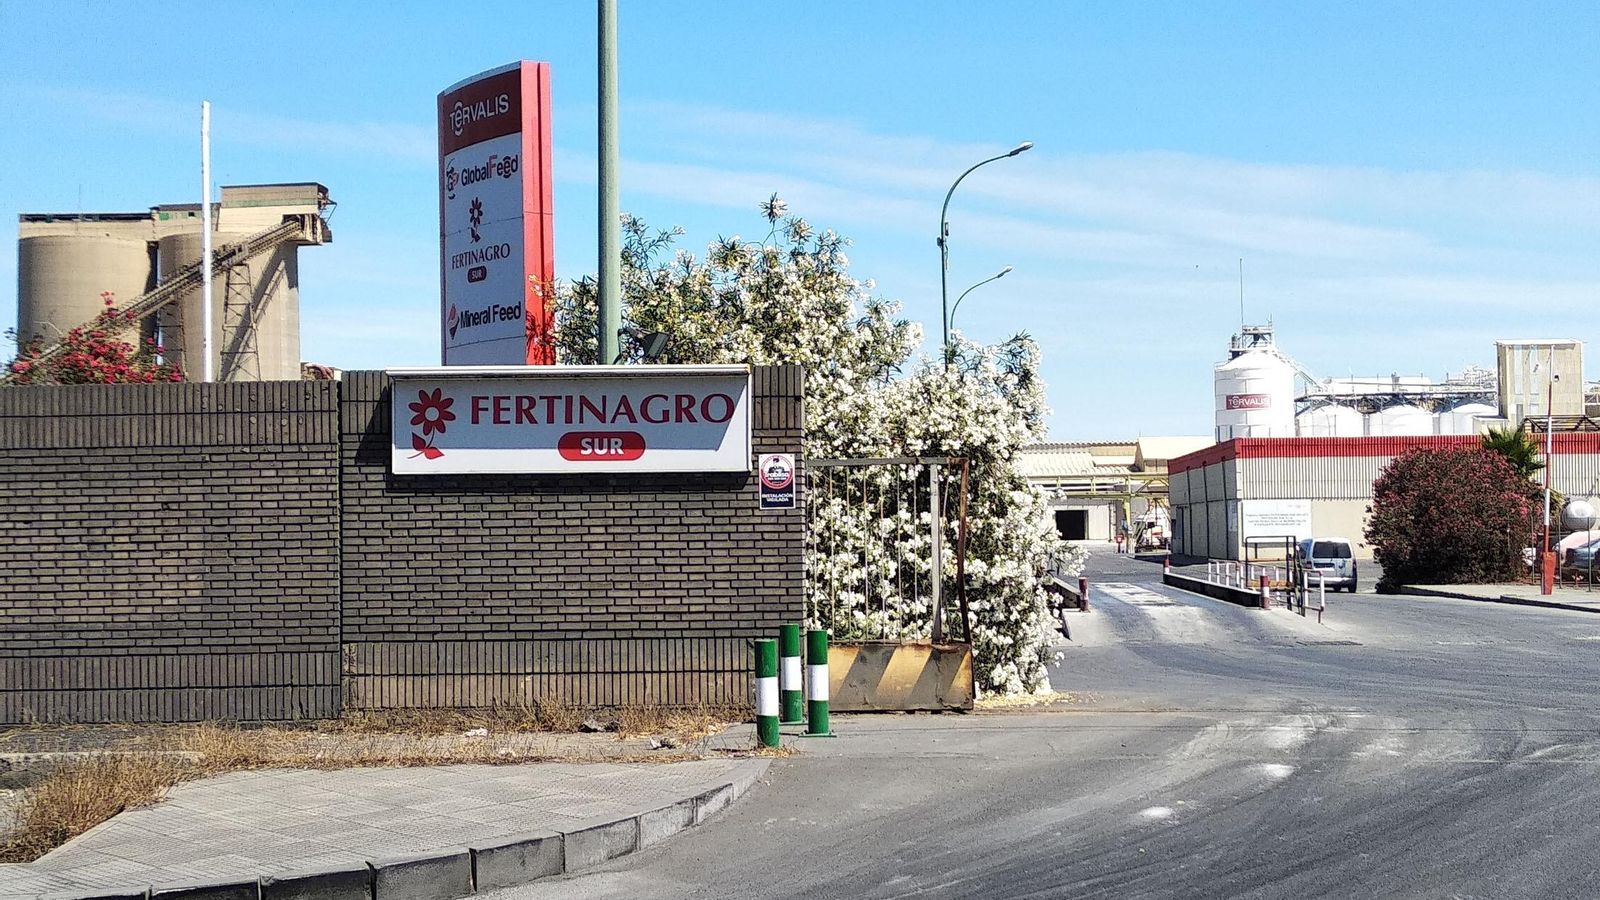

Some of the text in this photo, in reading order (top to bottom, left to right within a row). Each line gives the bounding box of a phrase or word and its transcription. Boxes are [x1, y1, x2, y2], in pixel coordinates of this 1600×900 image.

[452, 243, 511, 270] FERTINAGRO
[471, 269, 483, 280] SUR
[460, 301, 522, 329] Mineral Feed
[471, 393, 735, 425] FERTINAGRO
[580, 438, 624, 456] SUR
